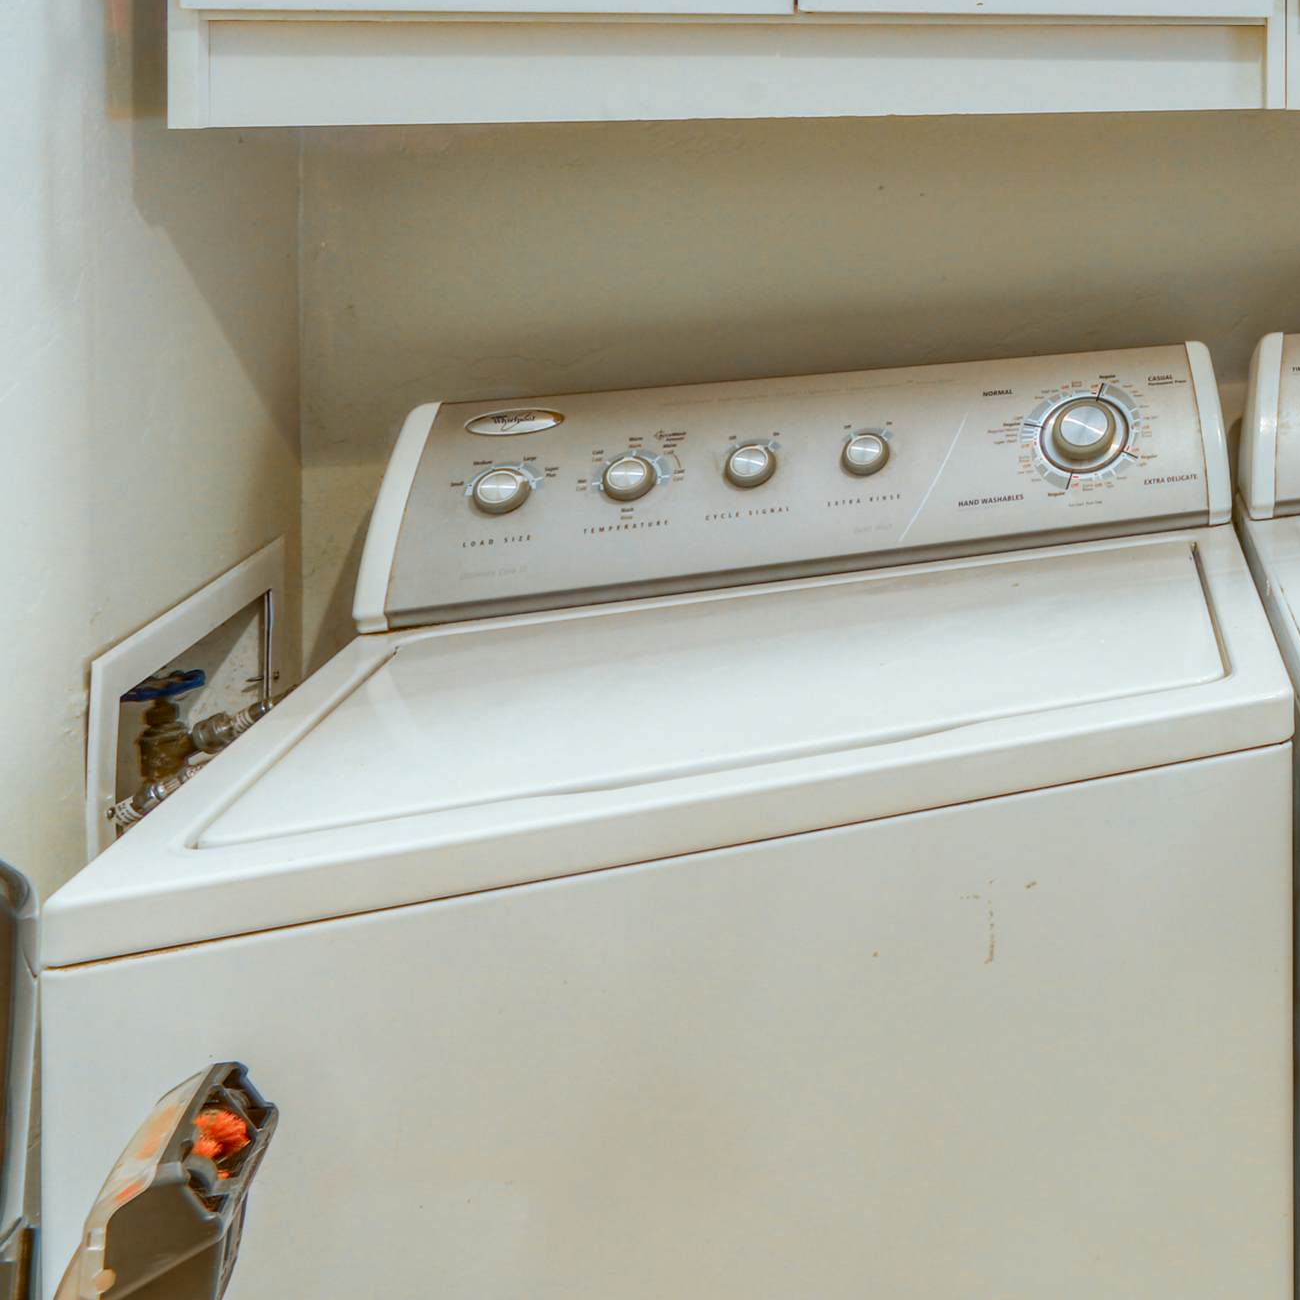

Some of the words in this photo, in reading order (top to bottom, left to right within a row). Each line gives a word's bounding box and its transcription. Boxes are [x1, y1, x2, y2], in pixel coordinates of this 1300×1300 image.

[1147, 374, 1174, 382] CASUAL
[982, 389, 1013, 398] NORMAL
[1143, 477, 1166, 486] EXTRA
[1167, 474, 1198, 484] DELICATE
[958, 499, 977, 508] HAND
[977, 494, 1024, 506] WASHABLES
[705, 511, 741, 522] CYCLE
[749, 505, 791, 517] SIGNAL
[583, 520, 670, 535] TEMPERATURE
[462, 538, 494, 548] LOAD
[504, 534, 533, 544] SIZE
